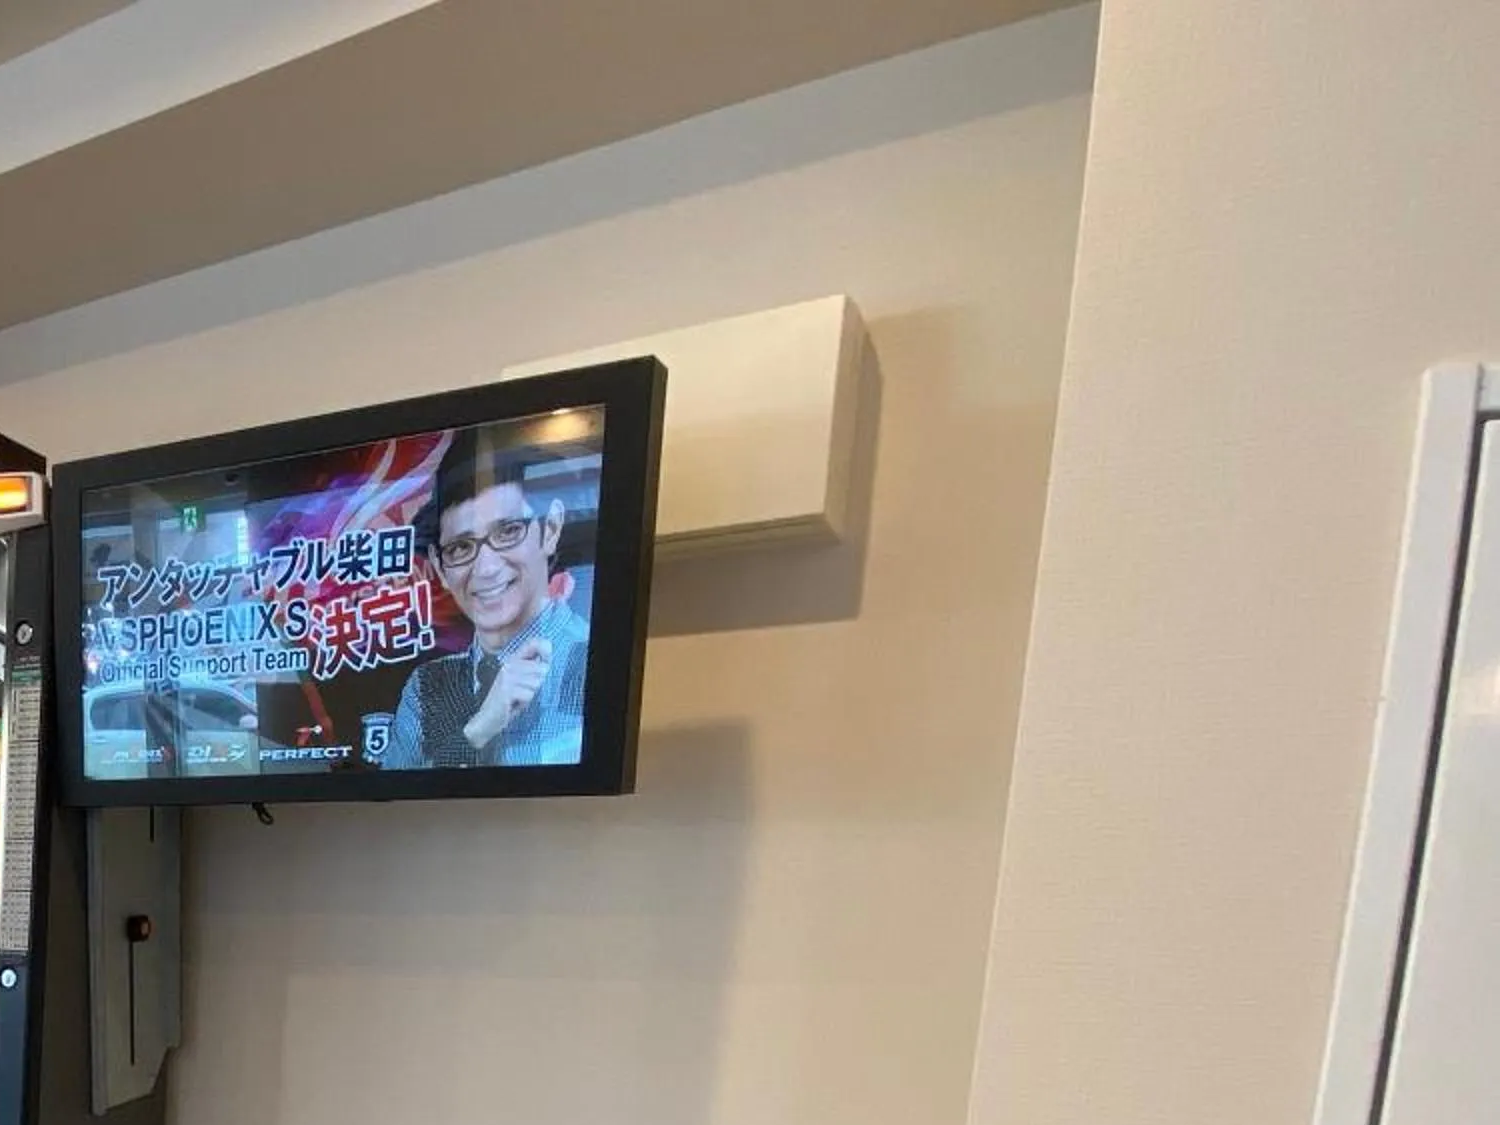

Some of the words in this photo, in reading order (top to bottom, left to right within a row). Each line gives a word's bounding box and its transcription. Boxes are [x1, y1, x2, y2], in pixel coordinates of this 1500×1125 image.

[252, 647, 307, 671] Team
[371, 729, 385, 751] 5
[259, 746, 352, 761] PERFECT
